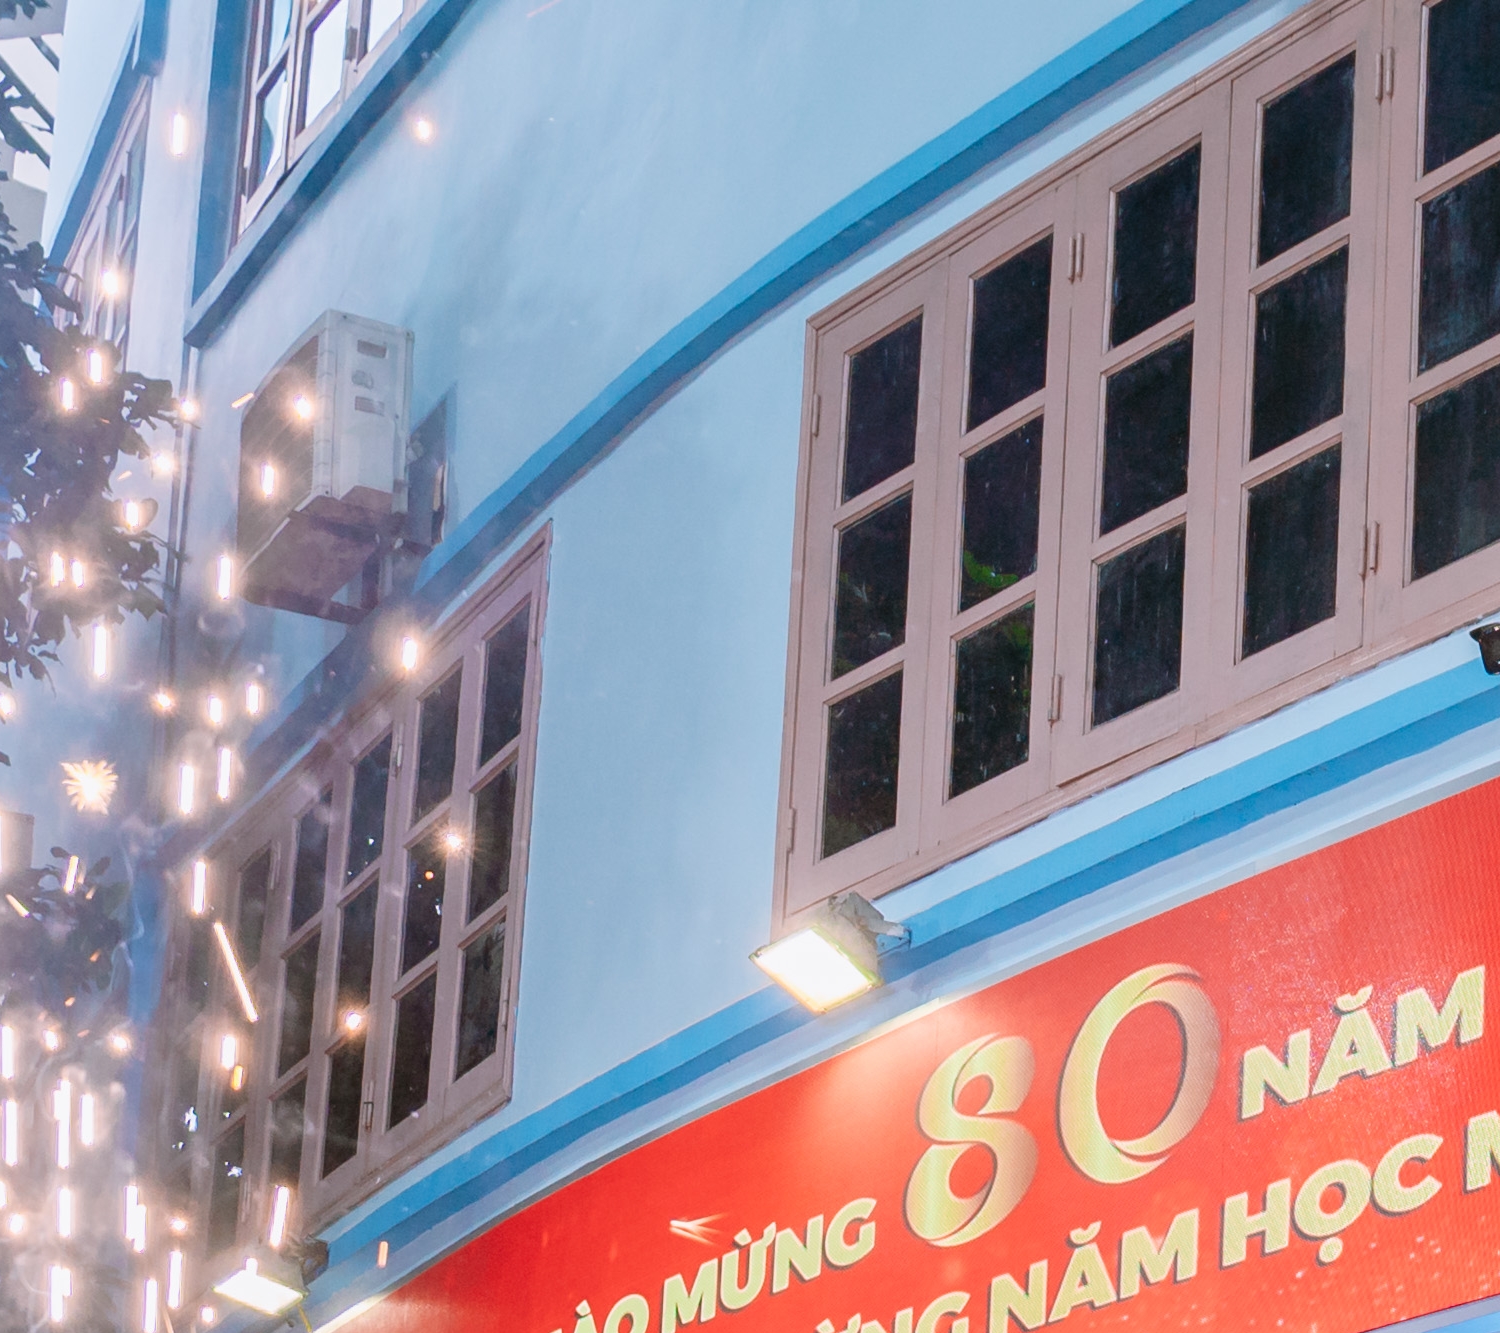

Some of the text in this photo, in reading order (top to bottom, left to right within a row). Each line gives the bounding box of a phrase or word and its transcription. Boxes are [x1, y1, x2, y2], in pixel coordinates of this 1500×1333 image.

[904, 961, 1222, 1249] 80
[1236, 964, 1487, 1121] NĂM
[1219, 1132, 1445, 1265] HỌC
